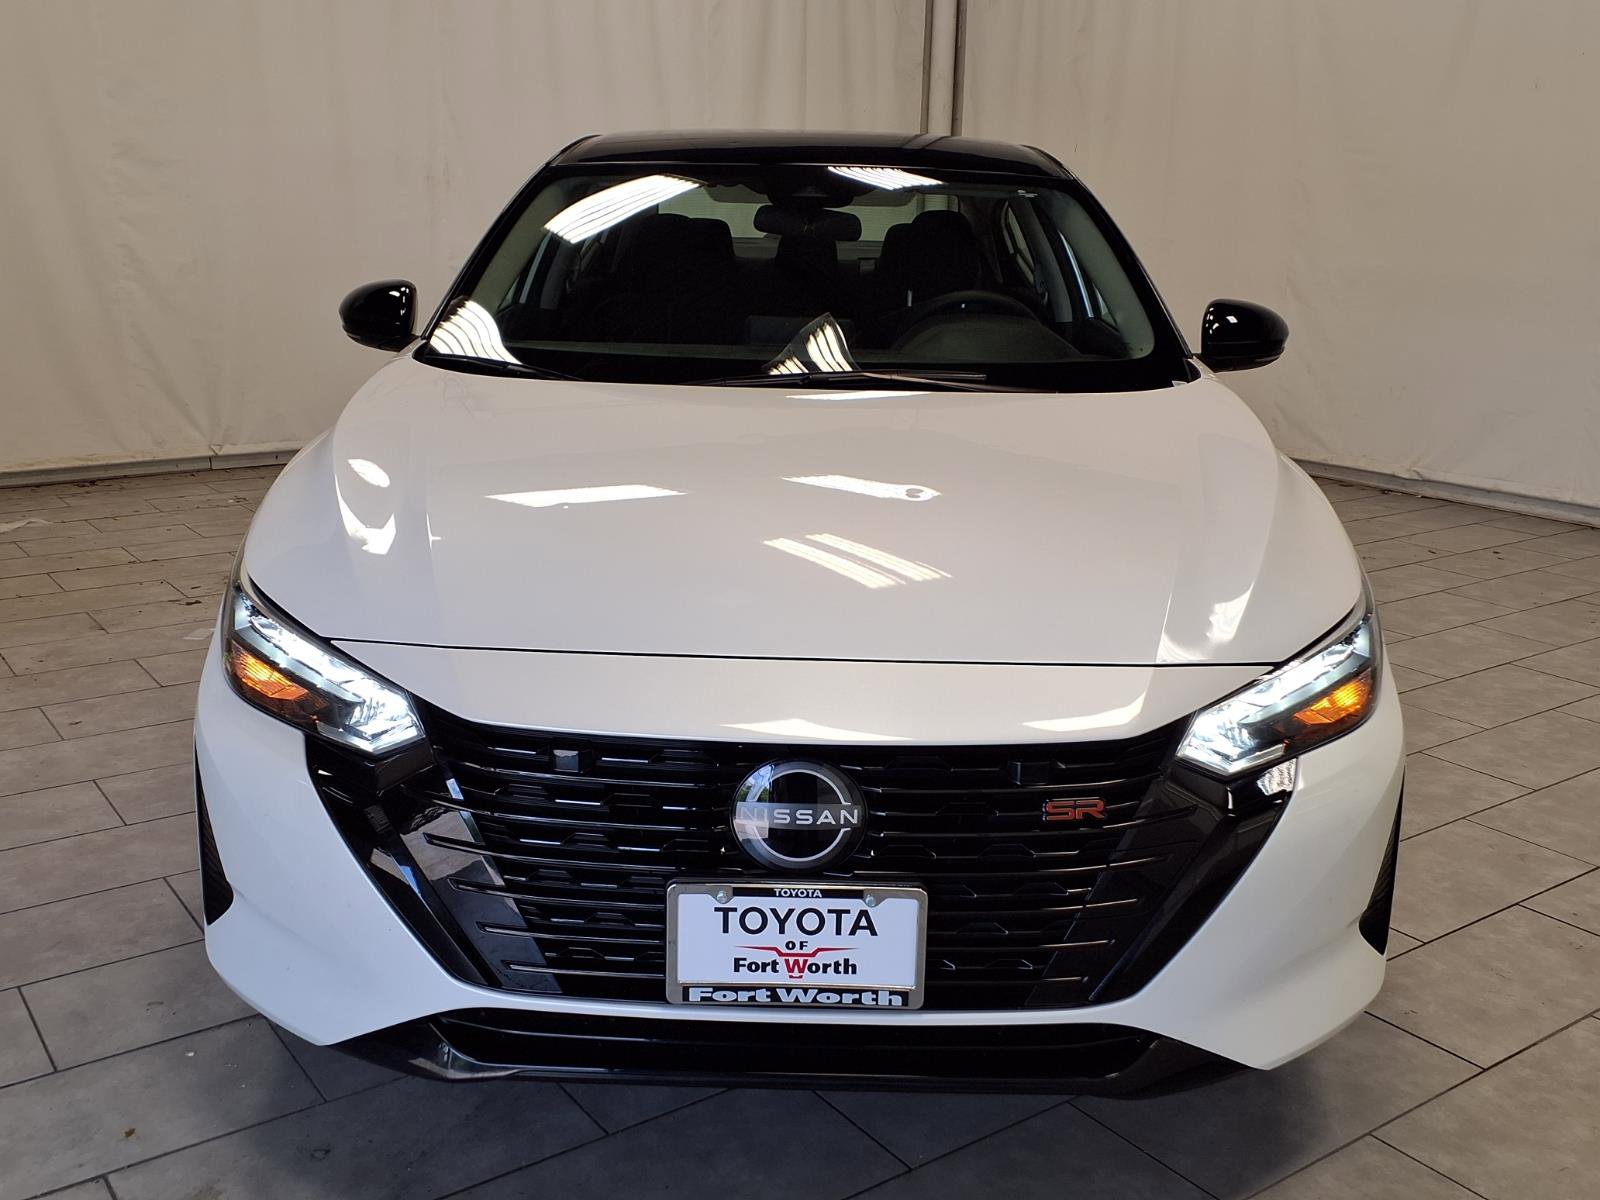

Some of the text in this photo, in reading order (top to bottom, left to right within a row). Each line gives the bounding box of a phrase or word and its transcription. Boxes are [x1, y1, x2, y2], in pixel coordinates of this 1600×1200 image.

[740, 807, 858, 824] NISSAN
[1045, 799, 1104, 820] SR
[774, 888, 822, 898] TOYOTA
[714, 906, 878, 936] TOYOTA
[785, 940, 808, 950] OF
[733, 957, 857, 976] Fort Worth
[688, 987, 902, 1006] Fort Worth
